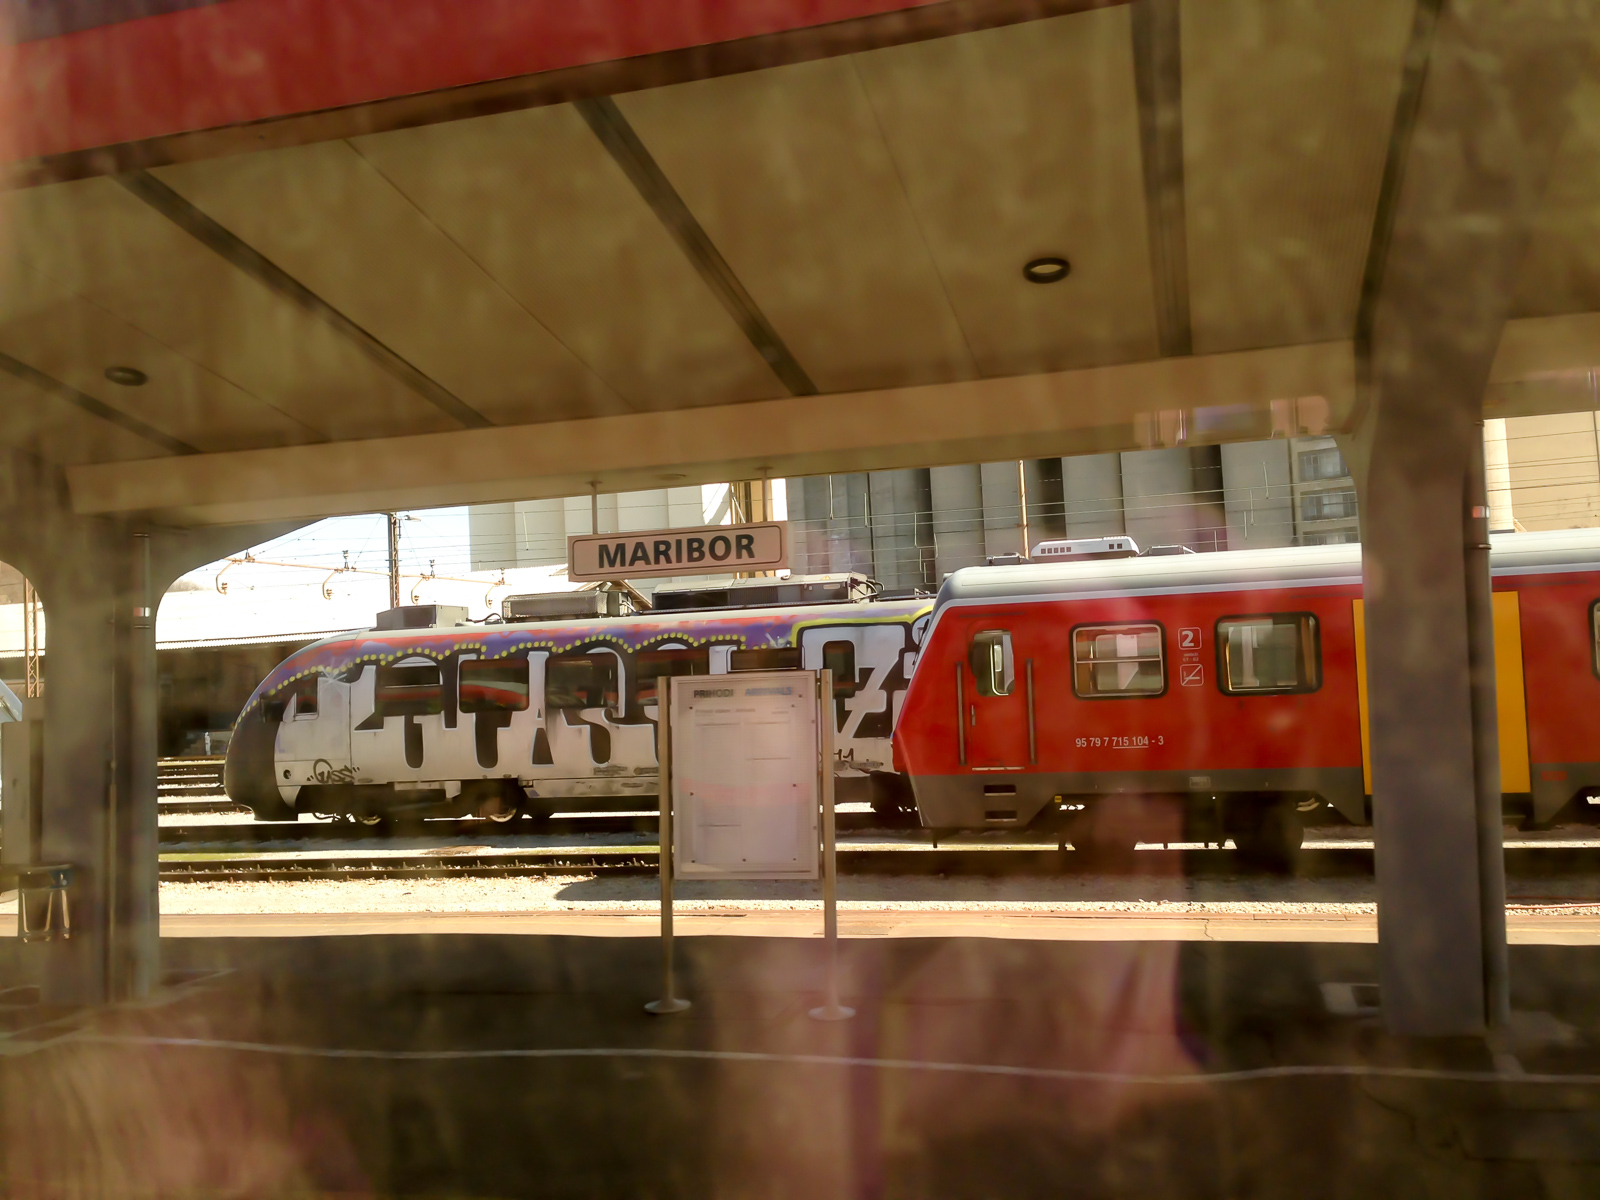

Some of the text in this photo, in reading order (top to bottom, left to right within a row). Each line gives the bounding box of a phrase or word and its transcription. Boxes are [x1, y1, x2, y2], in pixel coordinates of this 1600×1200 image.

[598, 534, 755, 568] MARIBOR
[1182, 630, 1194, 646] 2
[693, 688, 734, 698] PRIHODI
[1075, 737, 1087, 748] 95
[1089, 737, 1101, 747] 79
[1103, 736, 1109, 747] 7
[1111, 736, 1129, 747] 715
[1132, 735, 1149, 746] 104
[1157, 735, 1164, 746] 3
